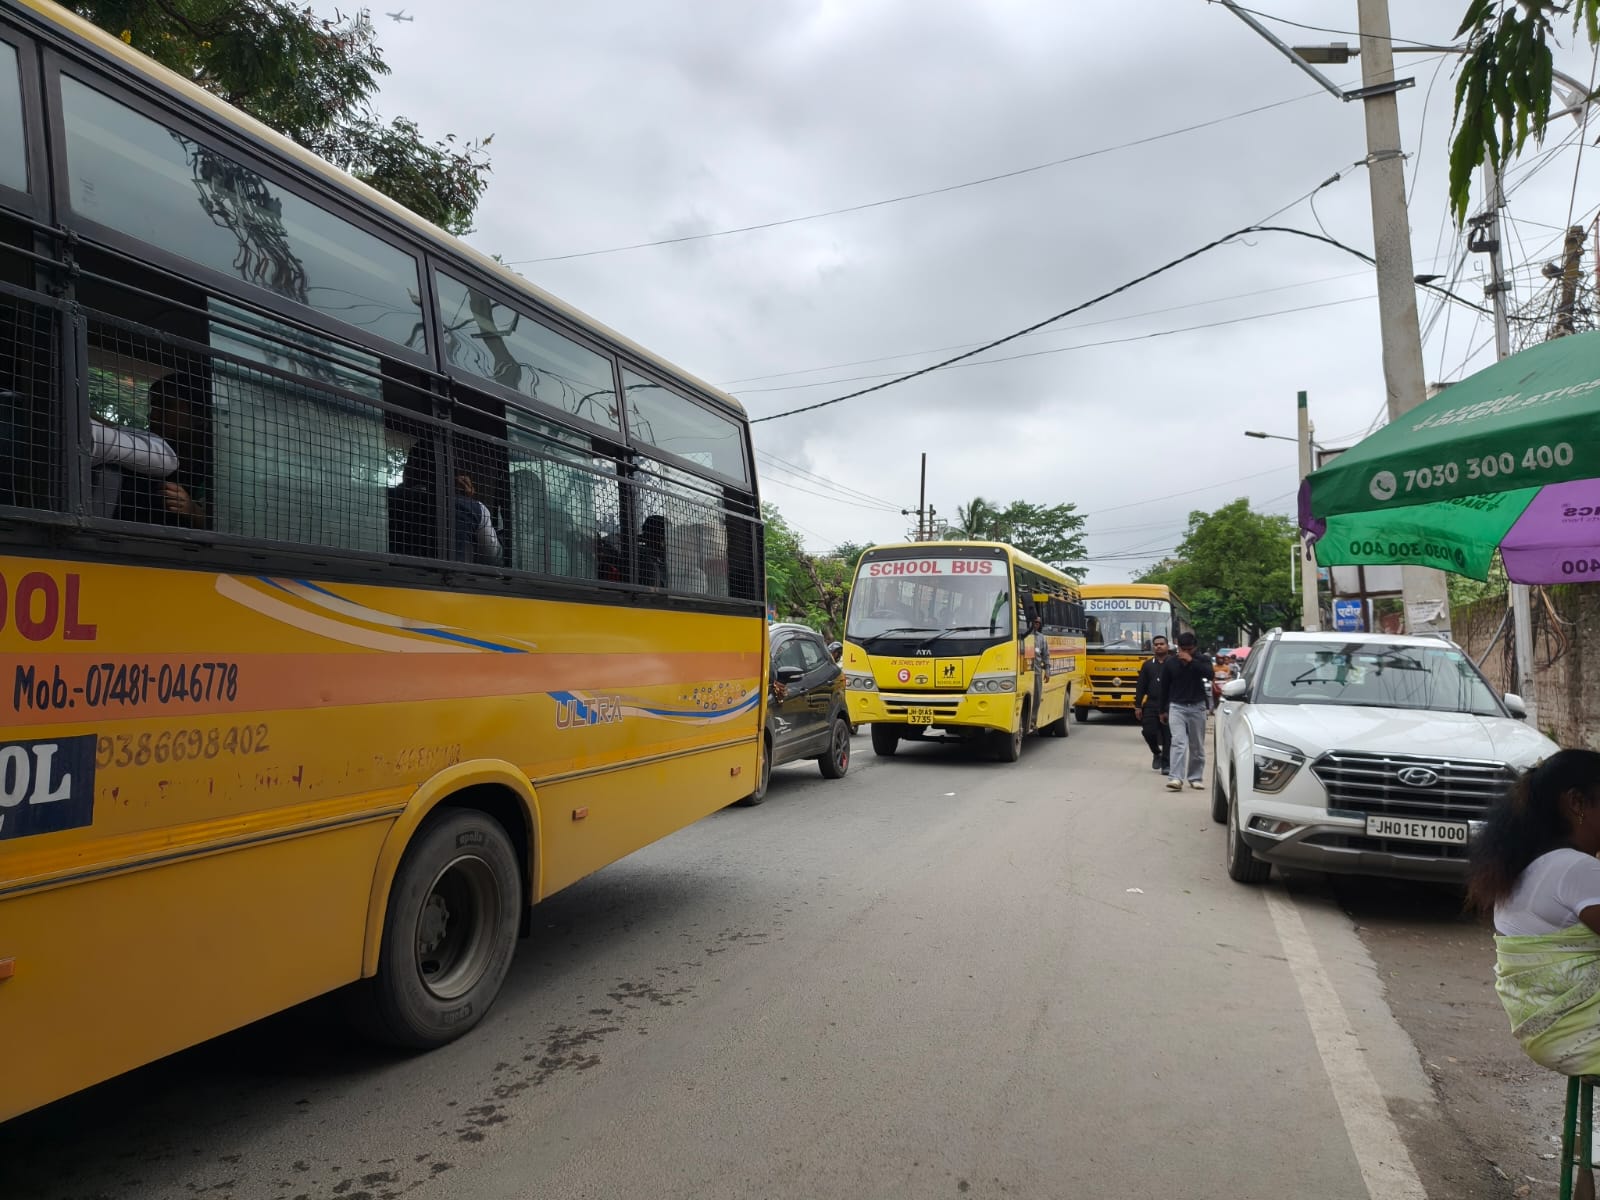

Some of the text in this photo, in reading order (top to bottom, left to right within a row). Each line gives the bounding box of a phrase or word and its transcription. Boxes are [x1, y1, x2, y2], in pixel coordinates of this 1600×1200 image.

[1403, 441, 1574, 492] 7030 300 400
[870, 560, 993, 576] SCHOOL BUS
[1090, 600, 1132, 610] SCHOOL
[1135, 600, 1163, 610] DUTY
[850, 653, 857, 663] L
[555, 695, 624, 730] ULTRA
[911, 716, 932, 724] 3735
[96, 723, 270, 769] 9386698402
[1375, 820, 1465, 841] JH01EY1000
